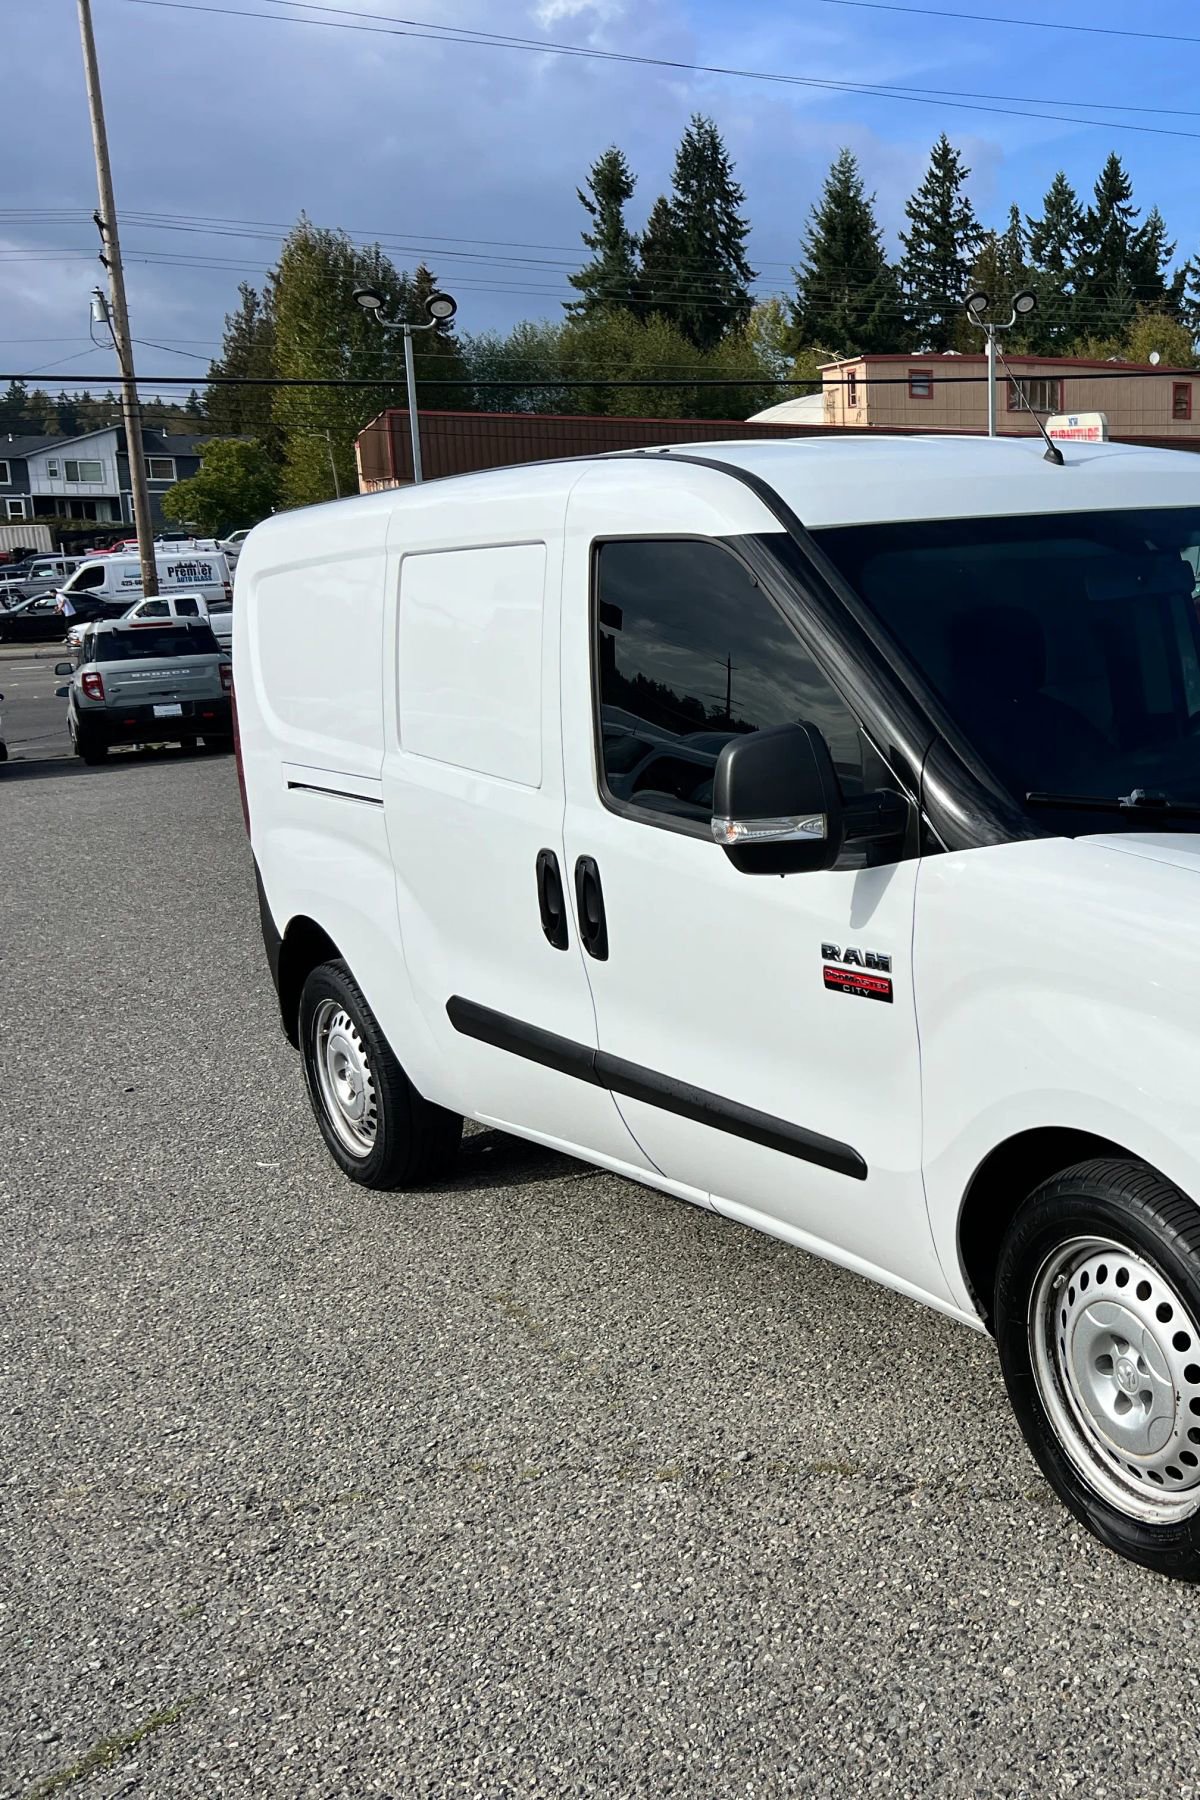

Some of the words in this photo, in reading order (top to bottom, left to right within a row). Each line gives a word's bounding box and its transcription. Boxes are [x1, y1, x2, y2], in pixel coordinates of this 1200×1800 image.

[131, 669, 190, 678] BRONCO
[821, 942, 892, 974] RAM
[842, 984, 870, 996] CITY
